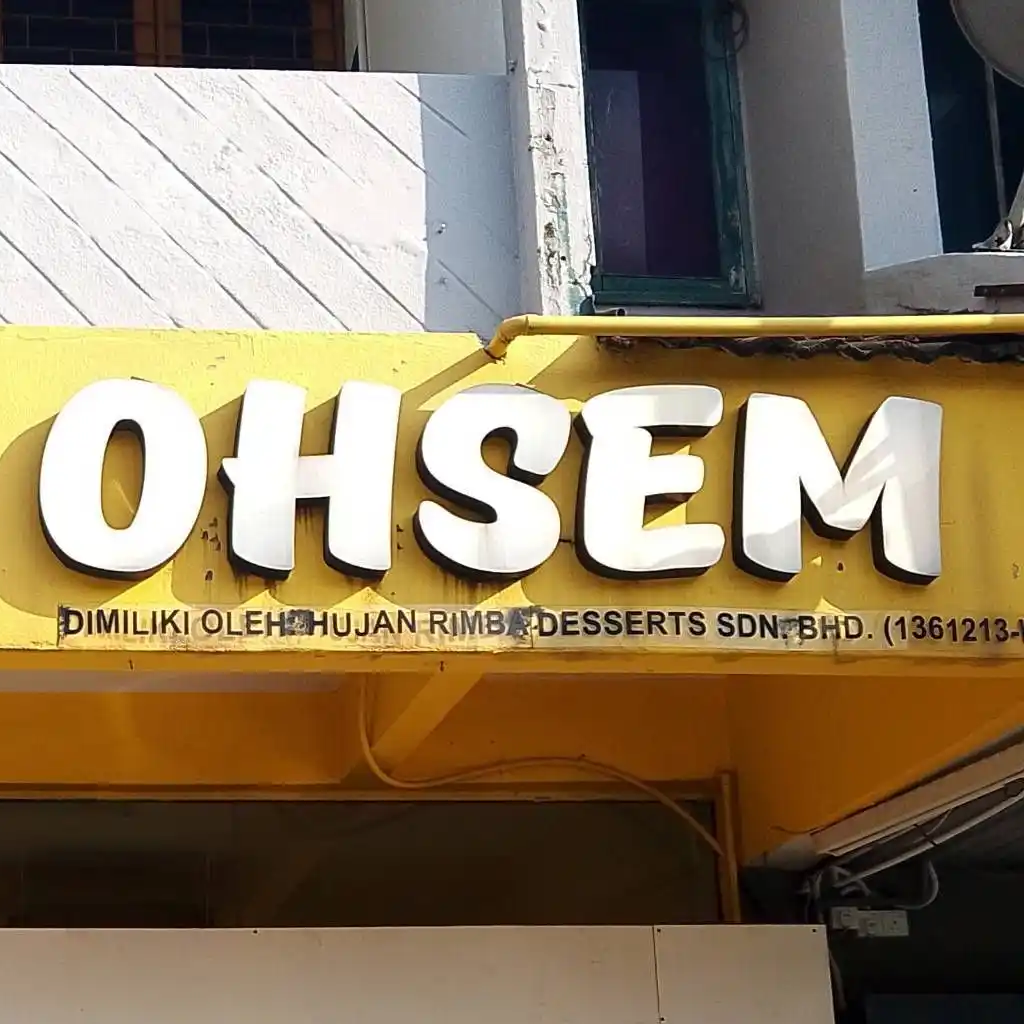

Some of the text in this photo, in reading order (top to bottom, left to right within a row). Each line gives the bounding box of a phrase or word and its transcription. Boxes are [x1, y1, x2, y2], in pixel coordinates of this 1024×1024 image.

[38, 377, 942, 585] OHSEM
[63, 608, 1024, 647] DIMILIKI OLEH HUJAN RIMBA DESSERTS SDN. BHD. (1361213-
